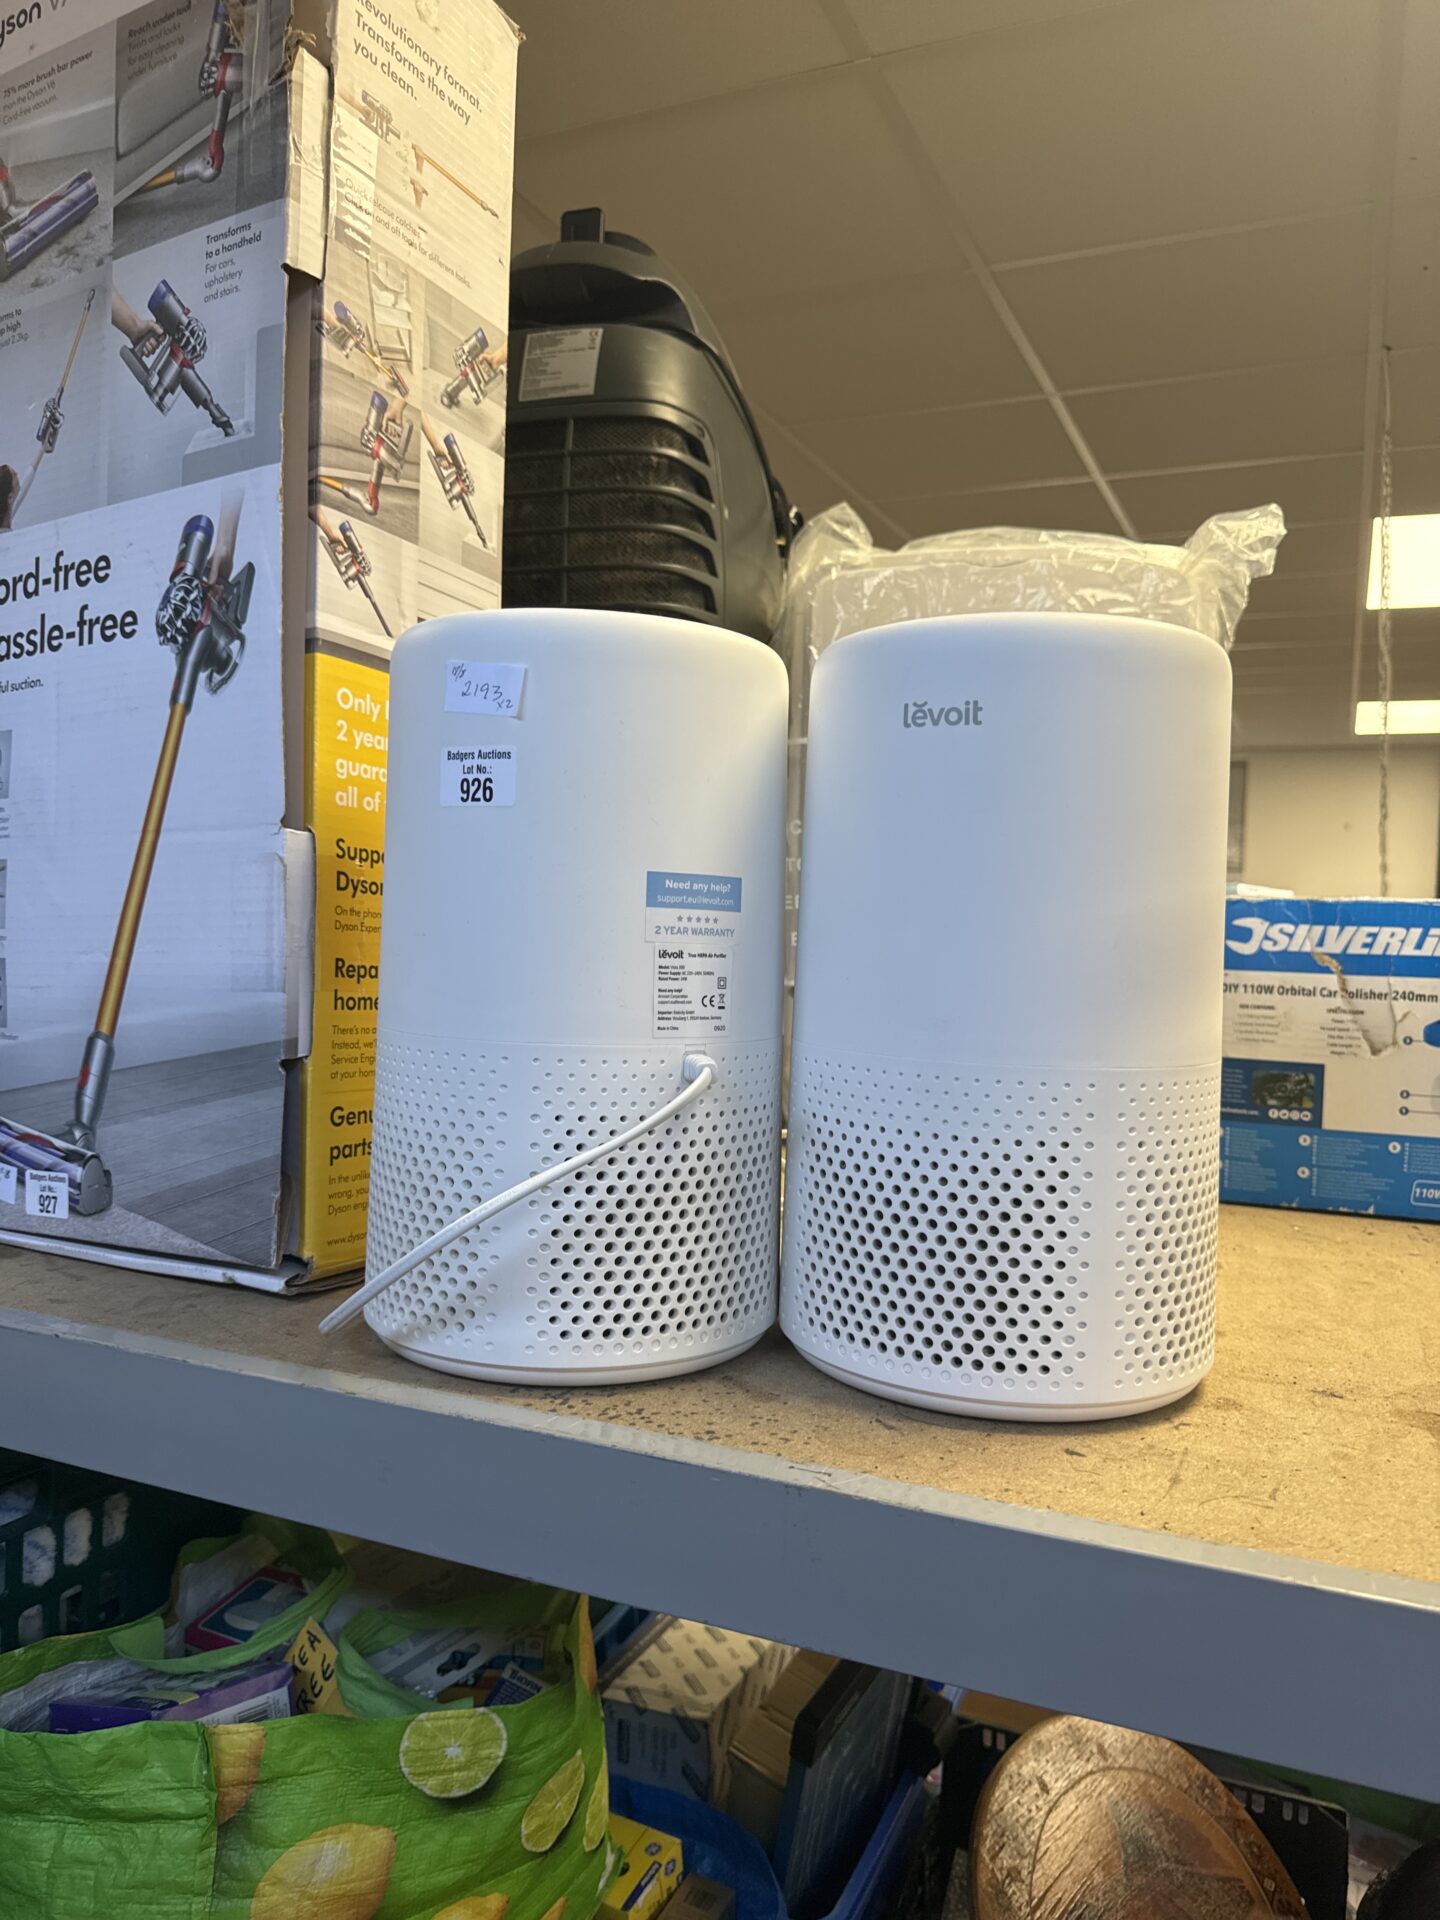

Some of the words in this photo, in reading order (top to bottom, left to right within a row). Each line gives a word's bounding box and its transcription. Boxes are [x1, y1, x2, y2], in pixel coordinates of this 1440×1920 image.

[36, 66, 56, 83] brush
[56, 62, 69, 73] bar
[70, 50, 93, 69] power
[353, 37, 378, 66] you
[381, 61, 418, 101] clean.
[355, 9, 426, 84] Transforms
[427, 75, 446, 102] the
[447, 95, 471, 126] way
[443, 65, 482, 113] format.
[205, 222, 252, 245] Transforms
[205, 250, 214, 260] to
[221, 230, 262, 254] handheld
[205, 263, 217, 274] For
[204, 269, 243, 290] upholstery
[204, 289, 219, 303] and
[220, 284, 240, 298] stairs.
[10, 676, 44, 692] suction.
[461, 680, 504, 702] 2193
[336, 687, 381, 723] Only
[336, 719, 348, 742] 2
[447, 750, 475, 763] Badgers
[477, 749, 512, 760] Auctions
[462, 764, 474, 775] Lot
[476, 764, 493, 775] No.:
[335, 785, 358, 809] all
[362, 791, 382, 814] of
[460, 777, 494, 803] 926
[665, 879, 690, 890] Need
[692, 883, 709, 893] any
[710, 884, 731, 895] help?
[335, 905, 348, 916] On
[349, 906, 361, 918] the
[335, 919, 358, 933] Dyson
[654, 925, 662, 935] 2
[664, 926, 689, 937] YEAR
[690, 927, 735, 938] WARRANTY
[334, 957, 379, 984] Repa
[1243, 984, 1274, 995] 110W
[1277, 985, 1316, 998] Orbital
[1319, 988, 1338, 999] Car
[1391, 990, 1439, 1003] 240mm
[332, 1025, 359, 1036] There's
[360, 1026, 371, 1035] no
[331, 1040, 361, 1051] Instead,
[331, 1054, 359, 1065] Service
[330, 1071, 338, 1080] at
[339, 1070, 357, 1081] your
[328, 1175, 336, 1185] In
[337, 1173, 350, 1184] the
[328, 1188, 354, 1200] wrong,
[39, 1194, 58, 1214] 927
[328, 1204, 352, 1217] Dyson
